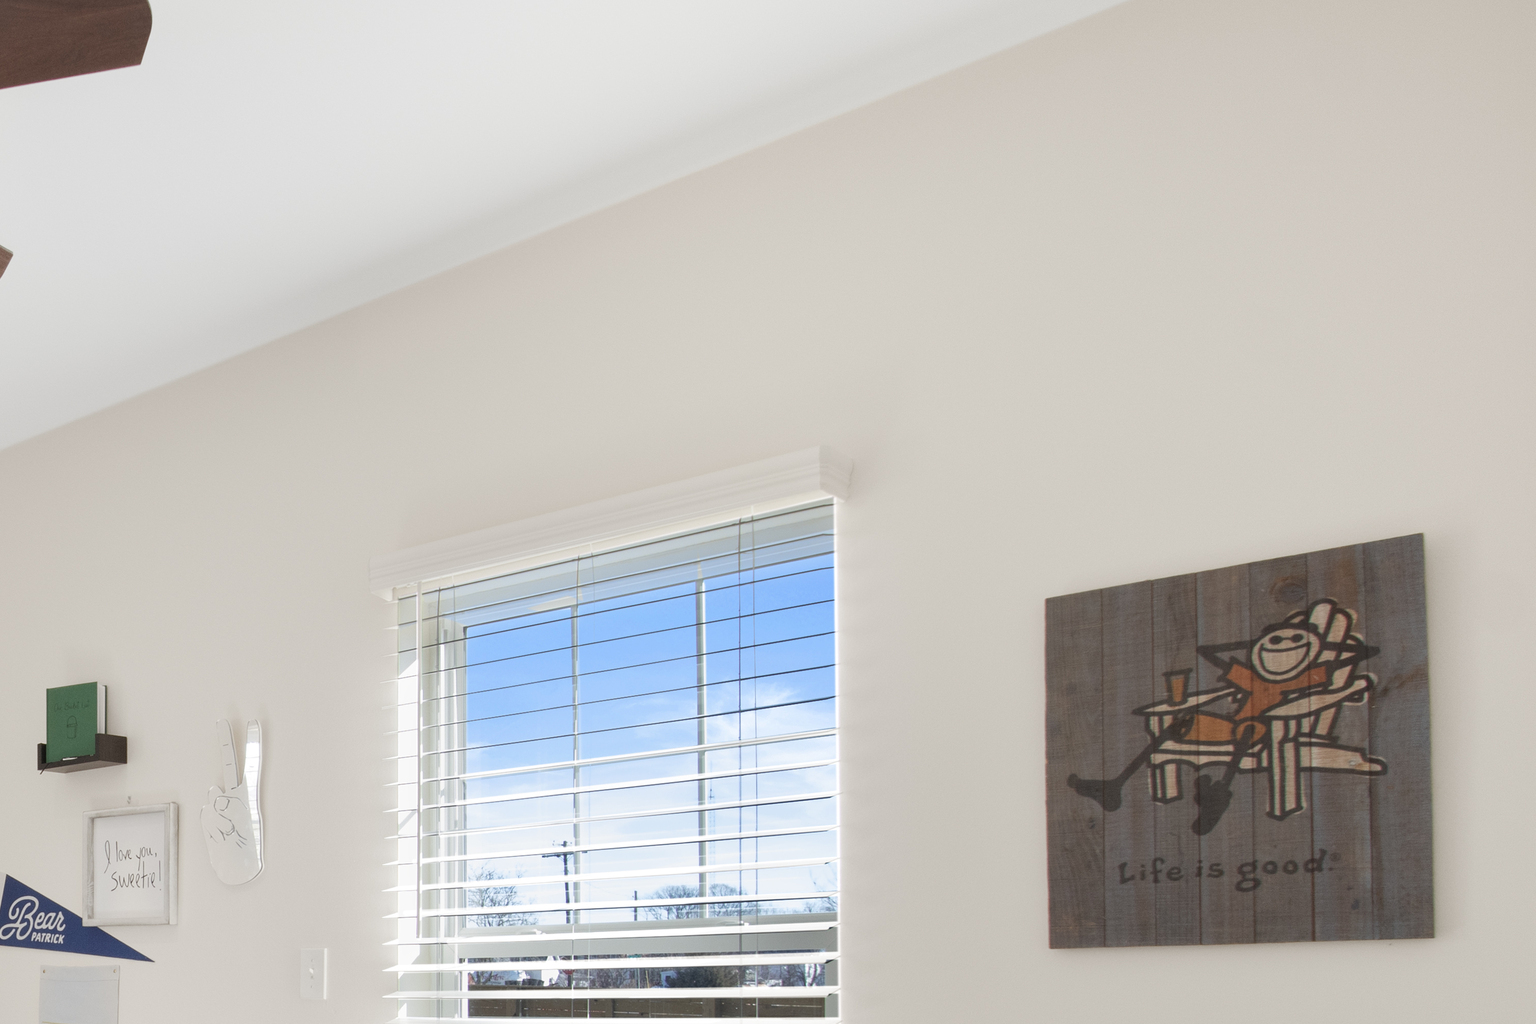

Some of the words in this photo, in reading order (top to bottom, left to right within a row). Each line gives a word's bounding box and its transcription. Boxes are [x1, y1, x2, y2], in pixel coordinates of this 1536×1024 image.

[116, 841, 132, 862] love
[1117, 857, 1185, 884] Life
[1195, 860, 1225, 878] is
[0, 895, 66, 941] Bear
[31, 932, 65, 944] PATRICK
